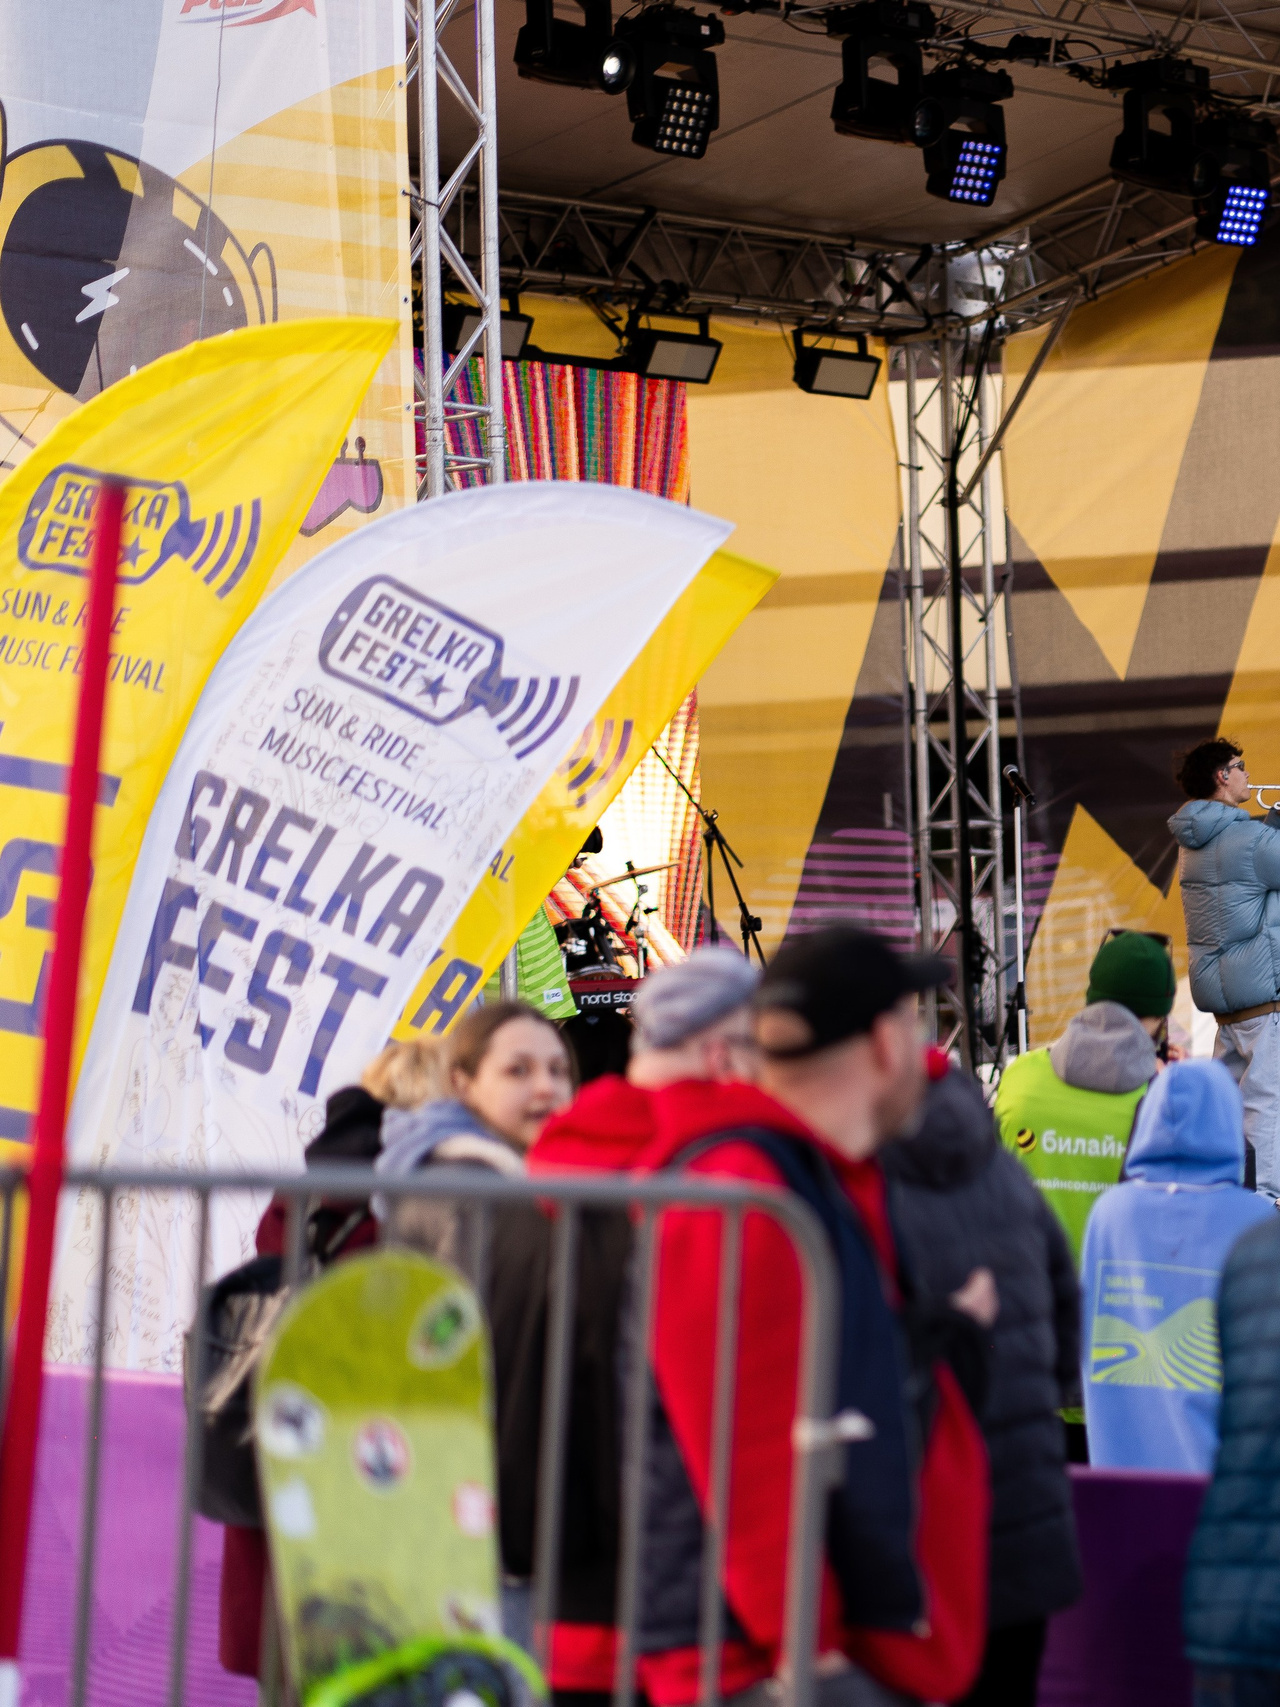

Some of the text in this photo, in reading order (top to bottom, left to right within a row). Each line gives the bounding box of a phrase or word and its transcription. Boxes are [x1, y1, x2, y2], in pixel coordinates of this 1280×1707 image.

[38, 520, 99, 560] FES
[54, 481, 170, 530] GRKA
[52, 600, 70, 626] &
[362, 592, 486, 673] GRELKA
[338, 630, 427, 691] FEST
[284, 687, 334, 731] SUN
[338, 714, 360, 742] &
[363, 728, 426, 772] RIDE
[258, 726, 450, 831] MUSIC FESTIVAL
[174, 769, 446, 958] GRELKA
[131, 877, 391, 1098] FEST
[580, 992, 612, 1005] nord
